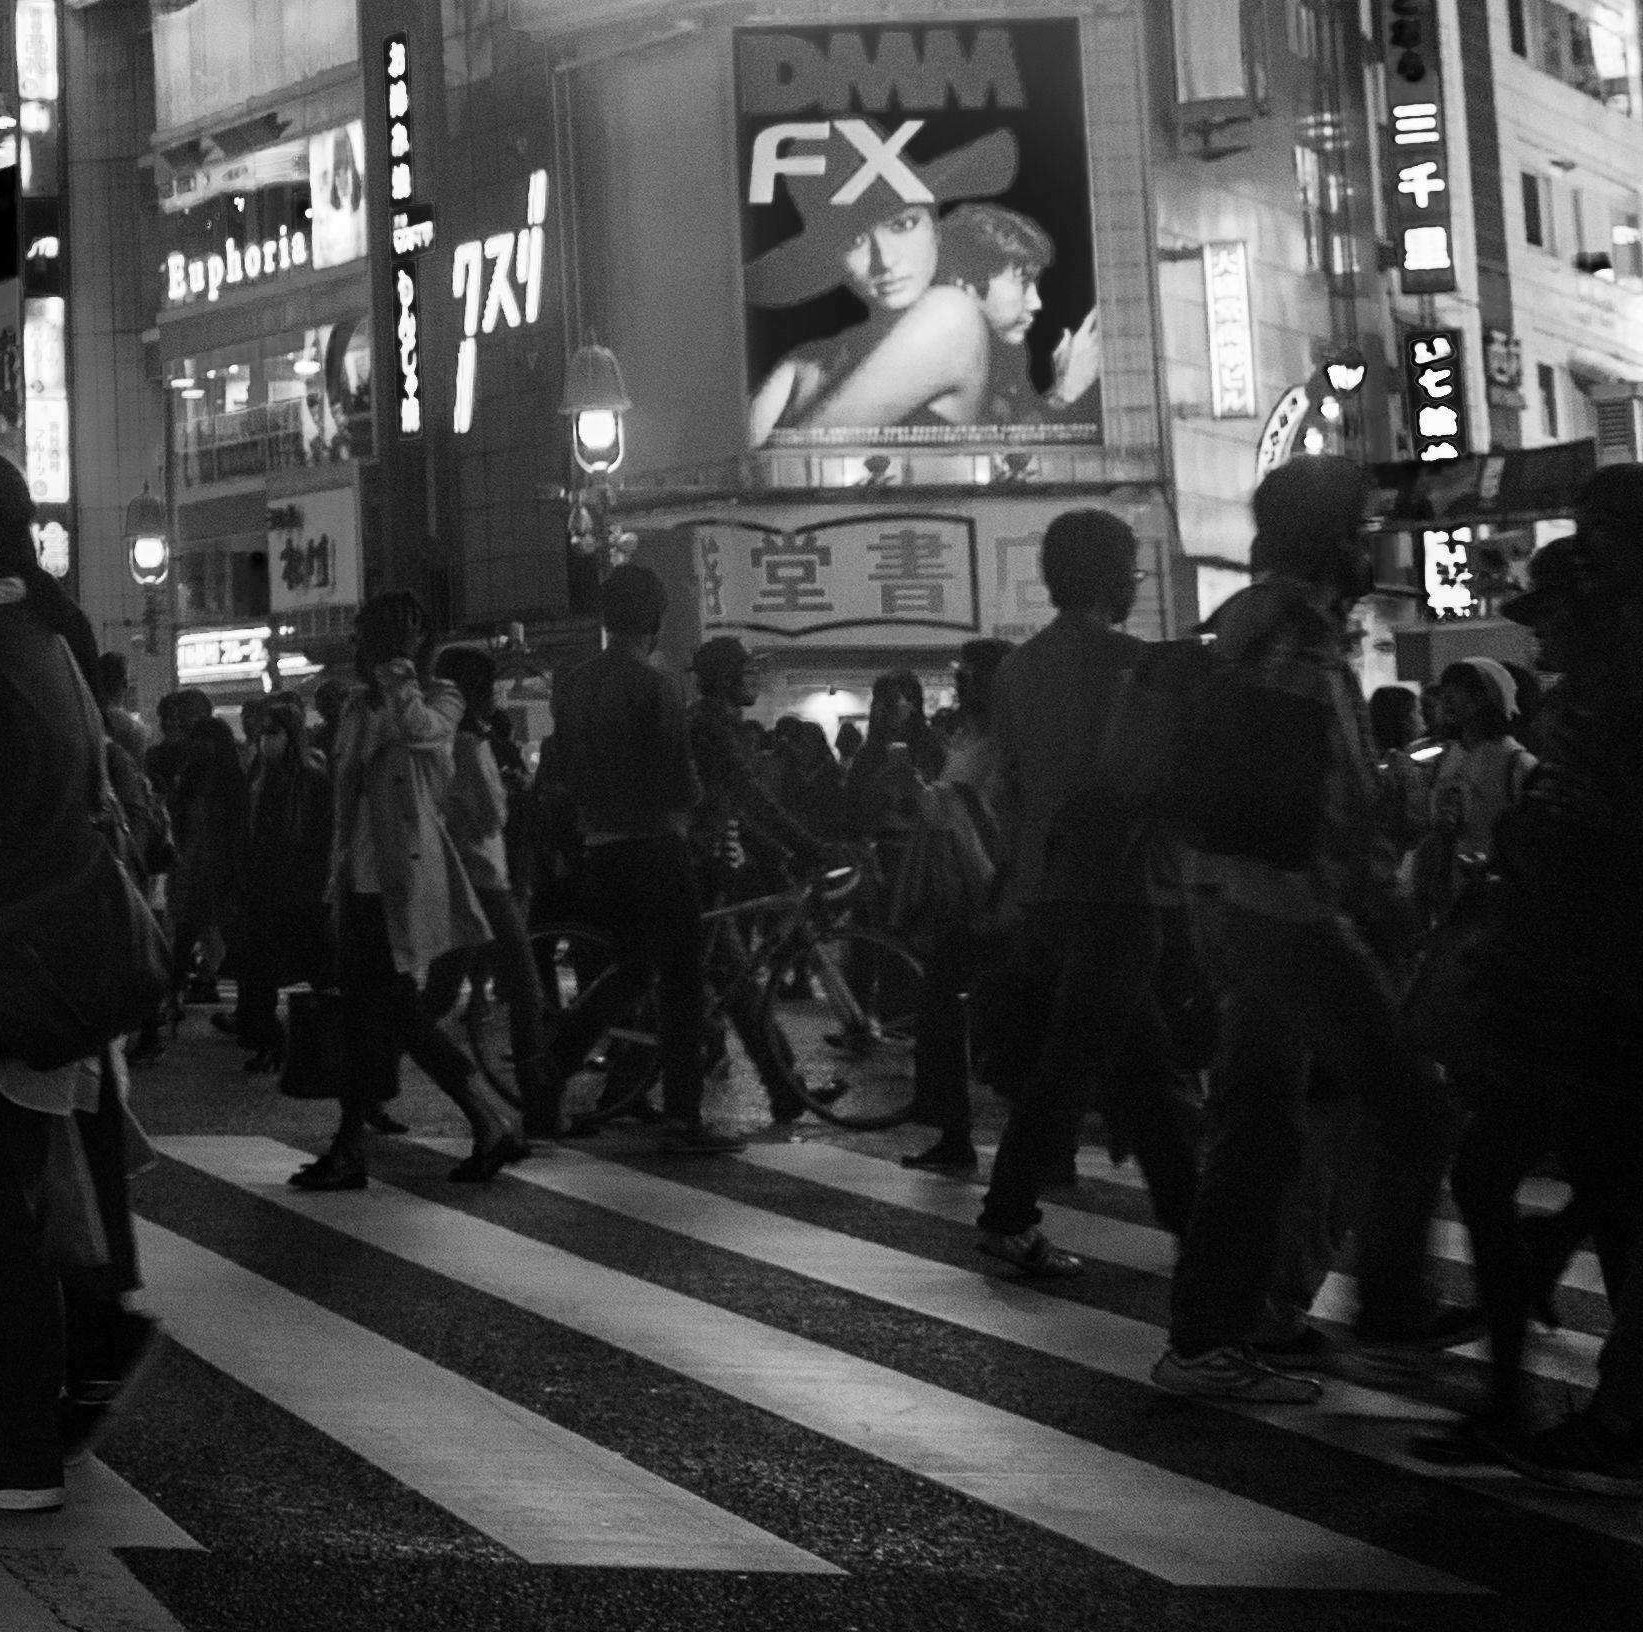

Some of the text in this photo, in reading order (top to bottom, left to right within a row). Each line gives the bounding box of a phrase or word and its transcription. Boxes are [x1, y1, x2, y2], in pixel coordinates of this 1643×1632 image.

[738, 26, 1031, 115] DMM
[747, 118, 936, 205] FX
[167, 226, 309, 302] Euphoria
